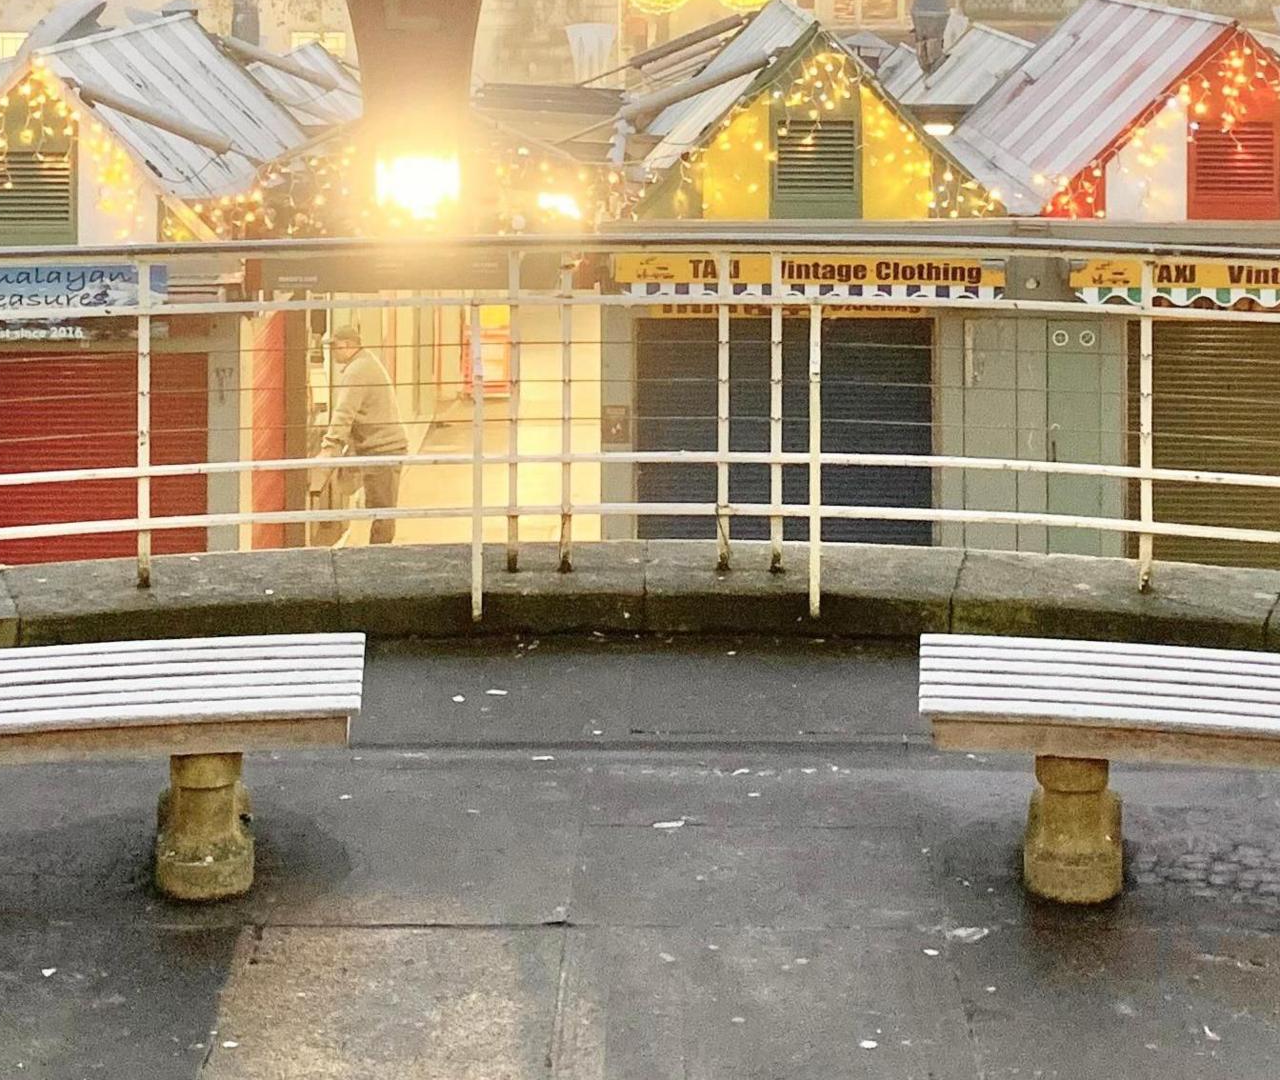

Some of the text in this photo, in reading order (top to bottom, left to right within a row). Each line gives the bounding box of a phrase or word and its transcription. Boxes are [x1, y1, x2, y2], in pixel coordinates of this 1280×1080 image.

[688, 259, 740, 280] TAI
[875, 261, 983, 285] Clothing
[12, 327, 46, 339] since
[50, 326, 84, 338] 2016
